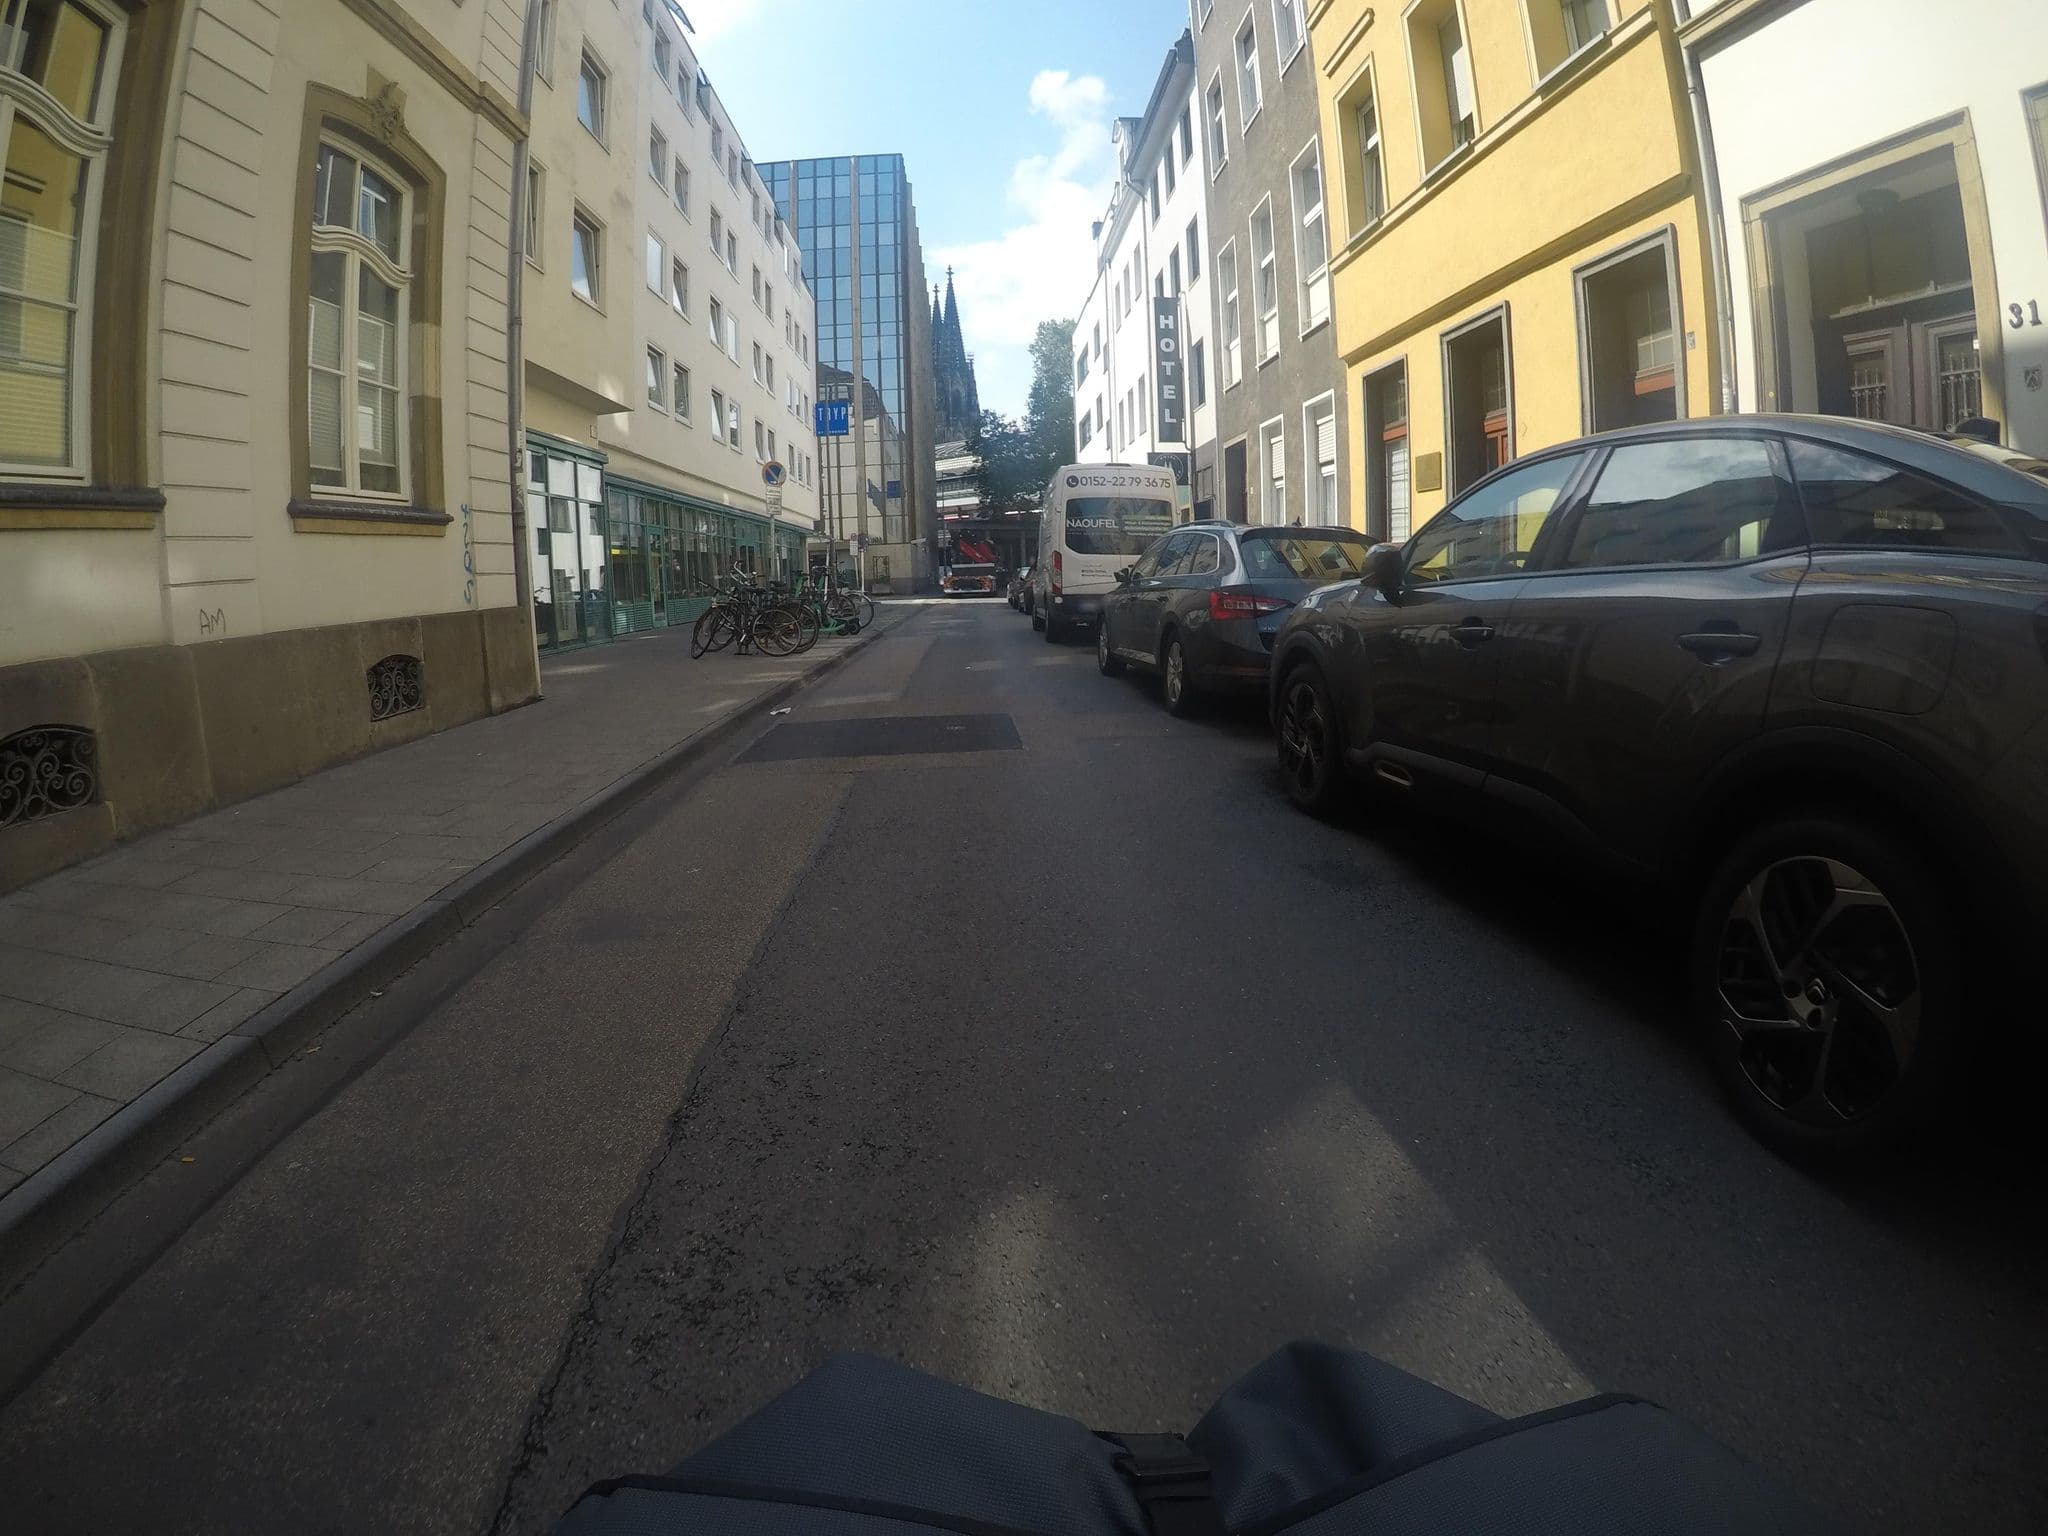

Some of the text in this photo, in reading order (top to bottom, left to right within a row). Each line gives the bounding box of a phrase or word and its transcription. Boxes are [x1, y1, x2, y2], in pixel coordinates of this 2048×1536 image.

[2008, 299, 2042, 329] 31
[1159, 315, 1177, 423] HOTEL
[1066, 519, 1119, 529] NAOUFEL
